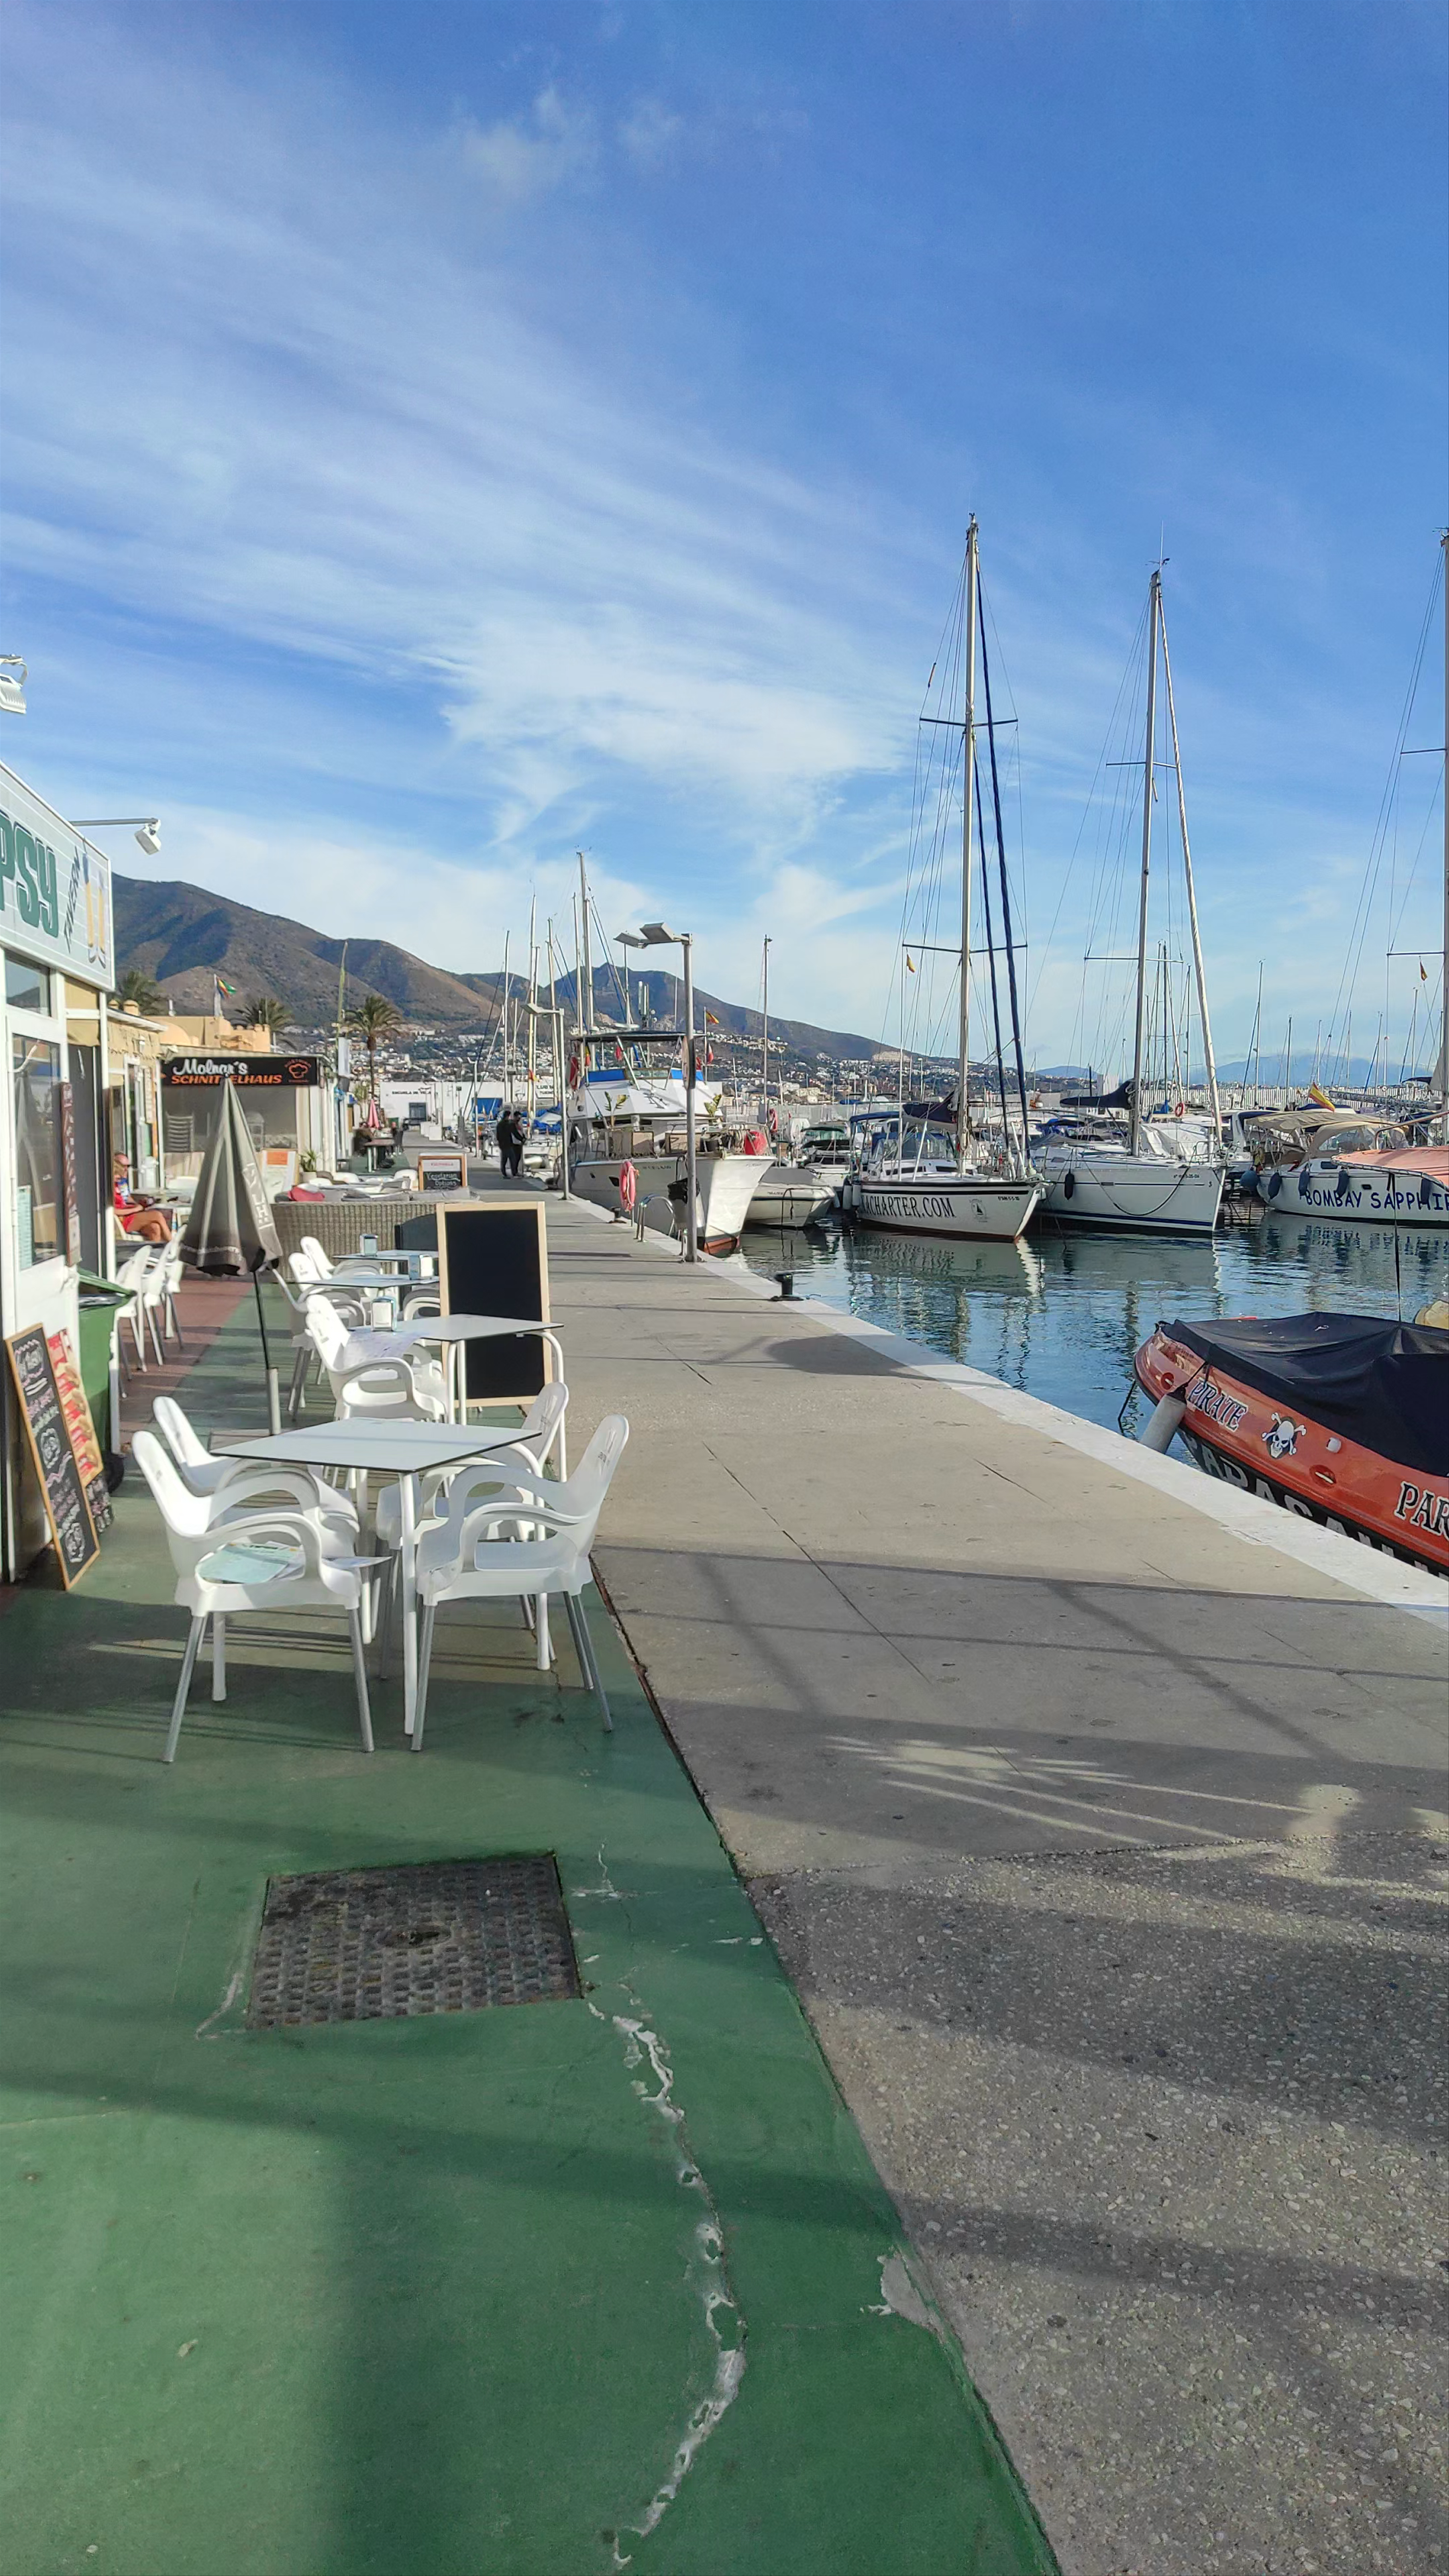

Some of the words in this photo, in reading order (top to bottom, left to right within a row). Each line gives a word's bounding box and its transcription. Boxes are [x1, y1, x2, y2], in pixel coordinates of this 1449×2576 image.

[171, 1075, 282, 1084] SCHNITELHAUS
[1306, 1189, 1361, 1208] BOMBAY
[1187, 1378, 1247, 1432] PIRATE
